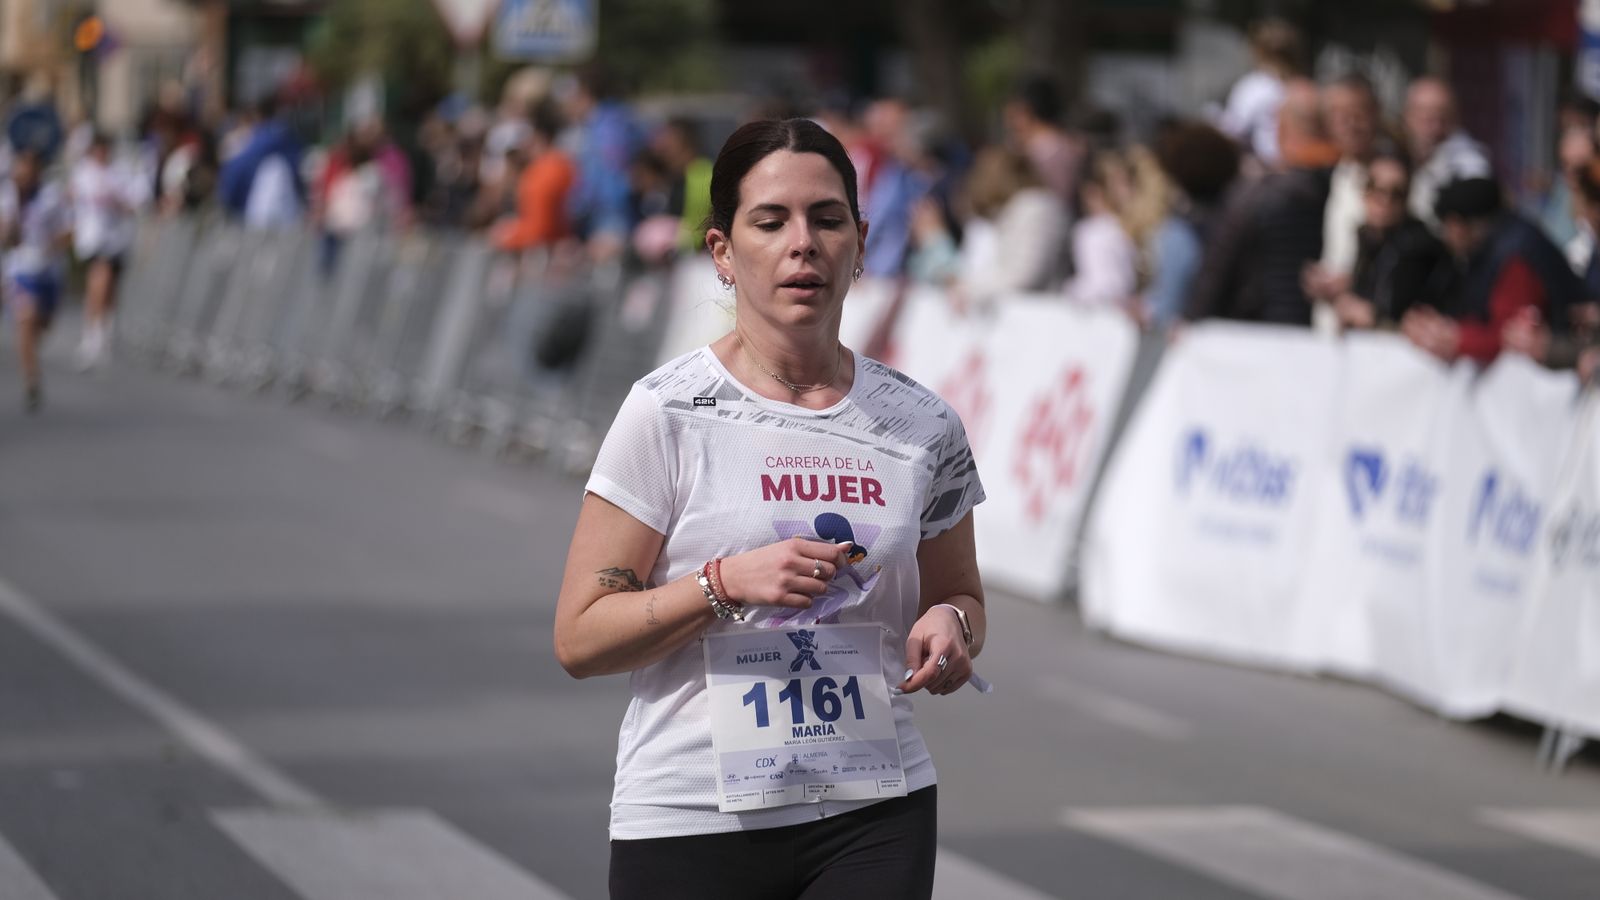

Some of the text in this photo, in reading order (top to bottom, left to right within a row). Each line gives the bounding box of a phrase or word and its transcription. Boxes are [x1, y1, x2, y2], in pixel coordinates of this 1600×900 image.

[765, 456, 875, 472] CARRERA DE LA
[760, 474, 886, 507] MUJER
[736, 651, 782, 665] MUJER
[742, 675, 865, 728] 1161
[792, 721, 836, 738] MARÍA
[784, 738, 802, 746] MARÍA
[803, 737, 817, 745] LEÓN
[755, 756, 778, 768] CDX
